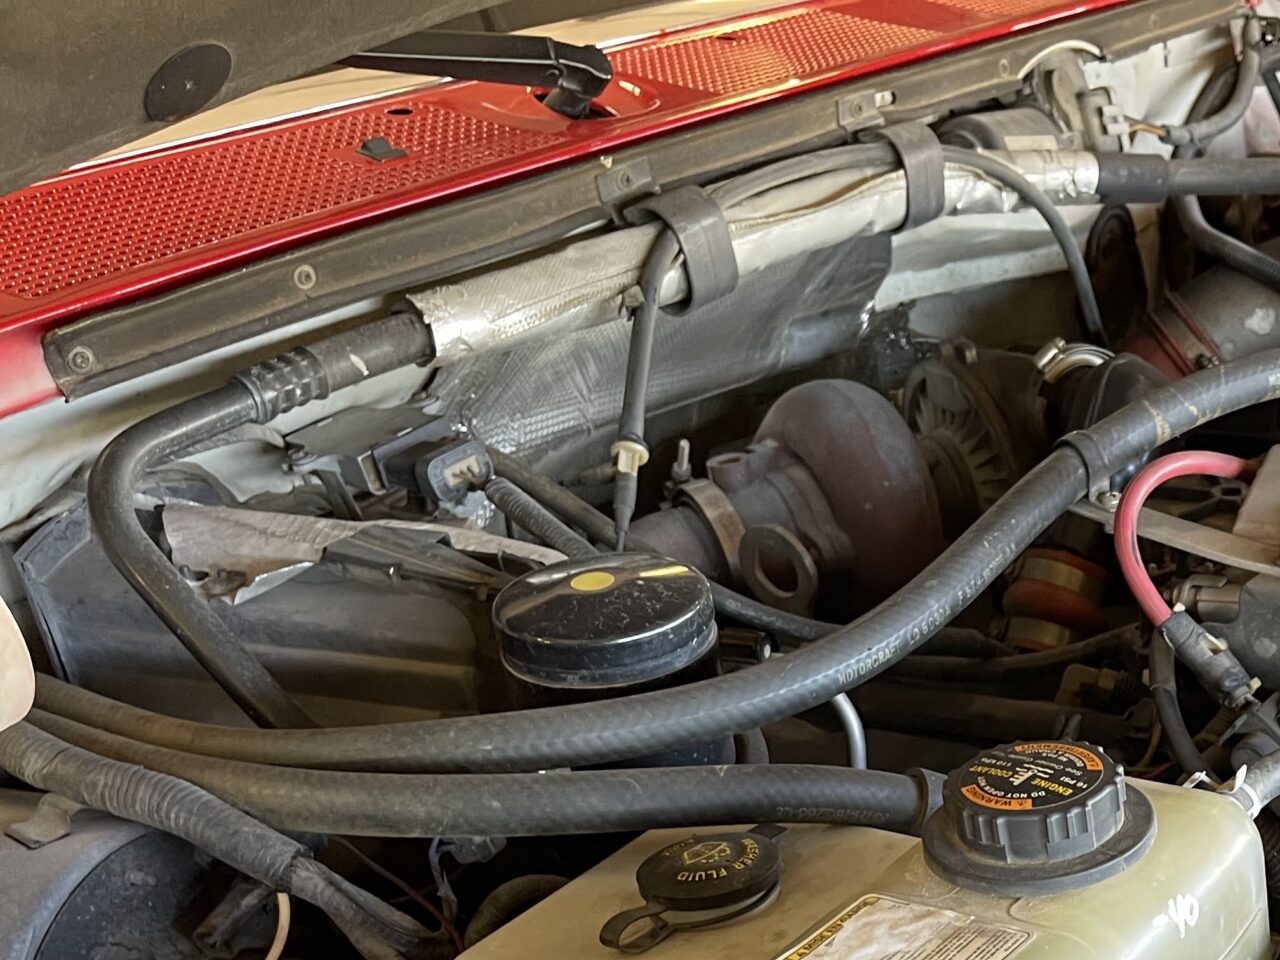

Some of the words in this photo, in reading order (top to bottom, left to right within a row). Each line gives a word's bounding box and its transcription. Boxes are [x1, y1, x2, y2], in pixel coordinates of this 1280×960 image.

[837, 641, 901, 685] MOTORCRAFT
[969, 765, 1012, 778] COOLANT
[1031, 778, 1073, 796] ENGINE
[1060, 776, 1076, 785] PSI
[966, 786, 1012, 807] WARNING
[984, 785, 1005, 797] OPEN
[1031, 790, 1045, 798] DO
[677, 868, 728, 881] FLUID
